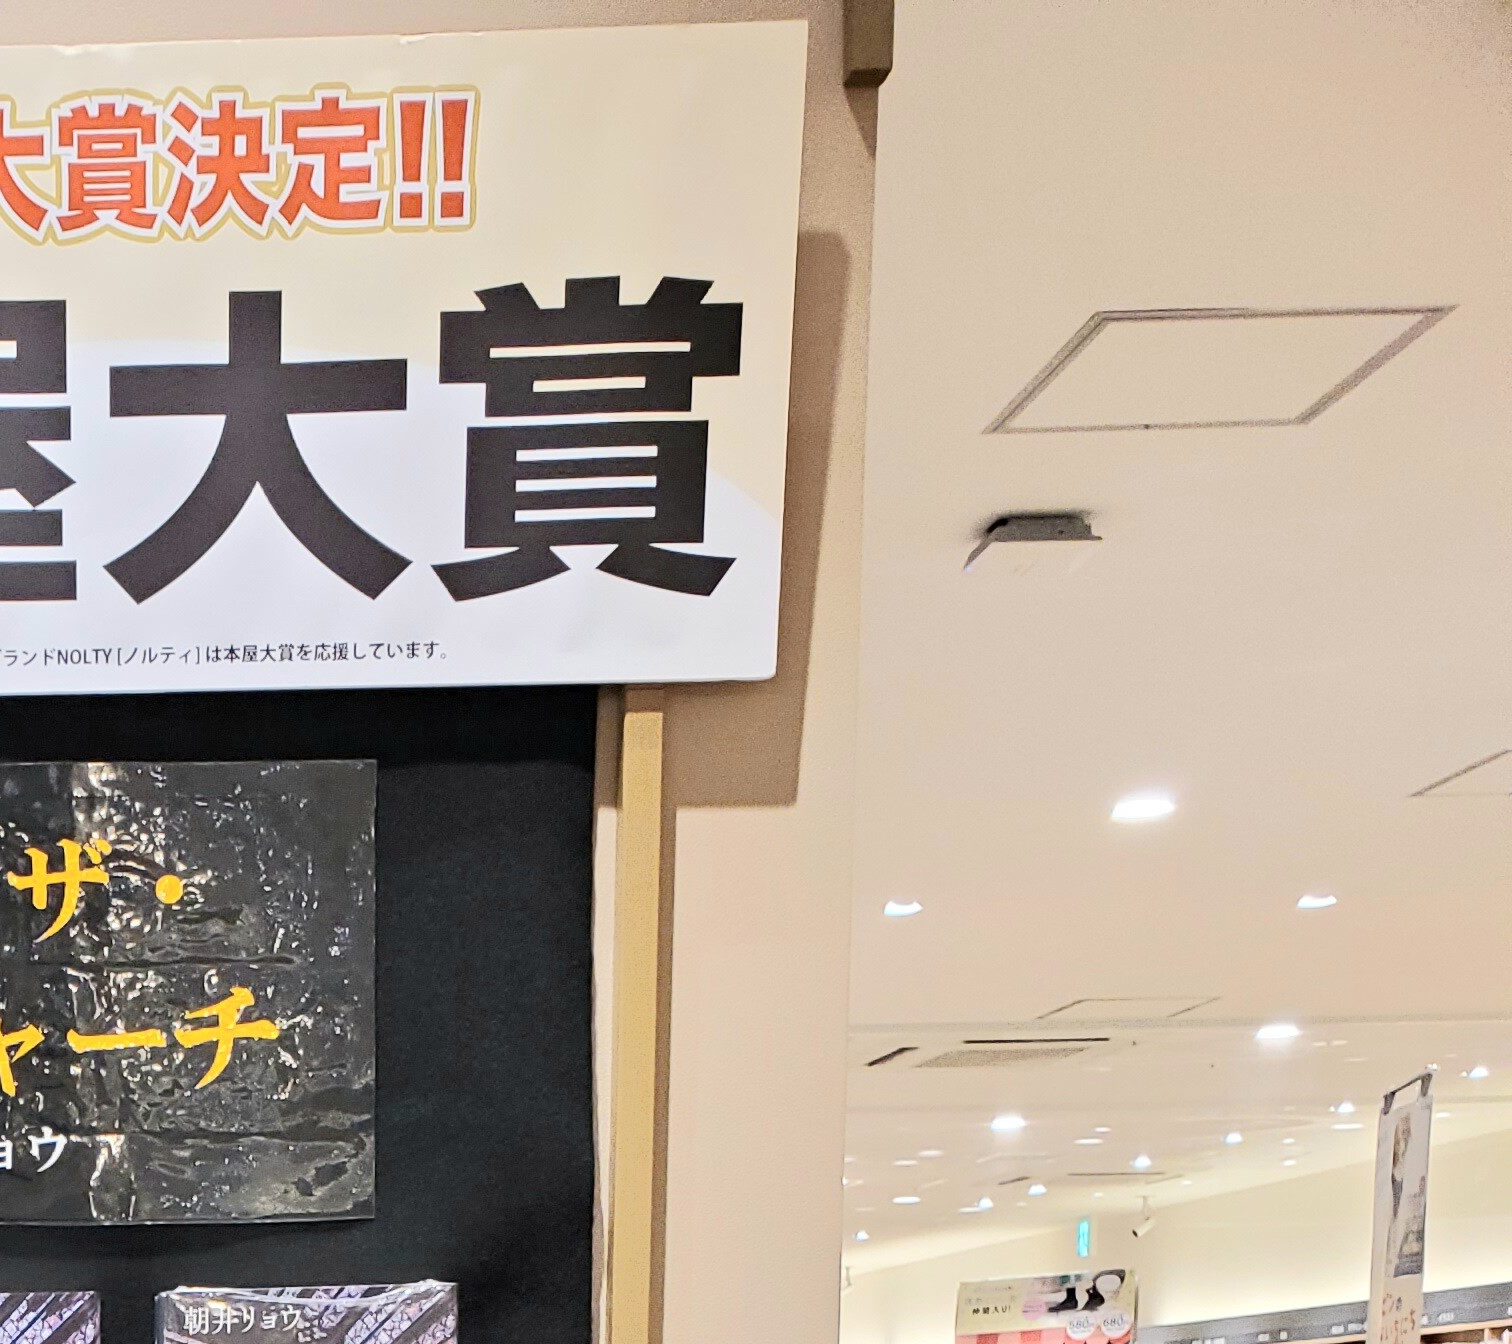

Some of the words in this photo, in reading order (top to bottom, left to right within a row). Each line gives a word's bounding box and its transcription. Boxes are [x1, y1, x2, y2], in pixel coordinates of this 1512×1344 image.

[183, 1305, 300, 1334] 朝井リョウ
